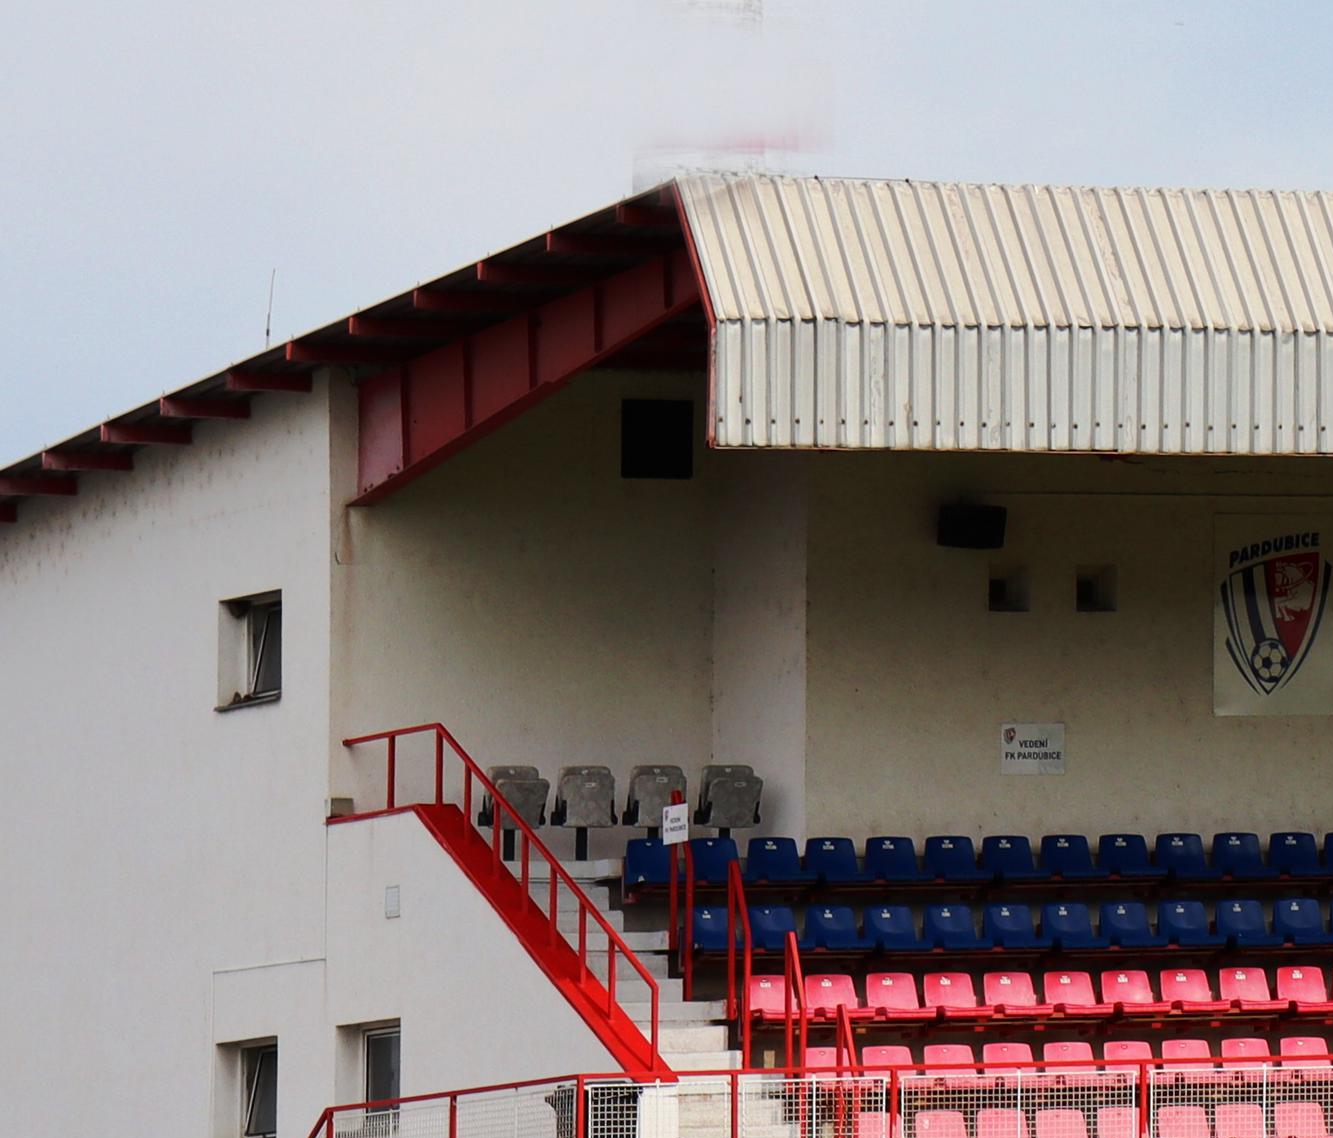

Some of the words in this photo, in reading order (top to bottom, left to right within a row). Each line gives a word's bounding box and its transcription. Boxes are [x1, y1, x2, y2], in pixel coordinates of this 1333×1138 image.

[1229, 532, 1320, 568] PARDUBICE
[1005, 752, 1015, 760] FK
[1017, 752, 1062, 760] PARDUBICE
